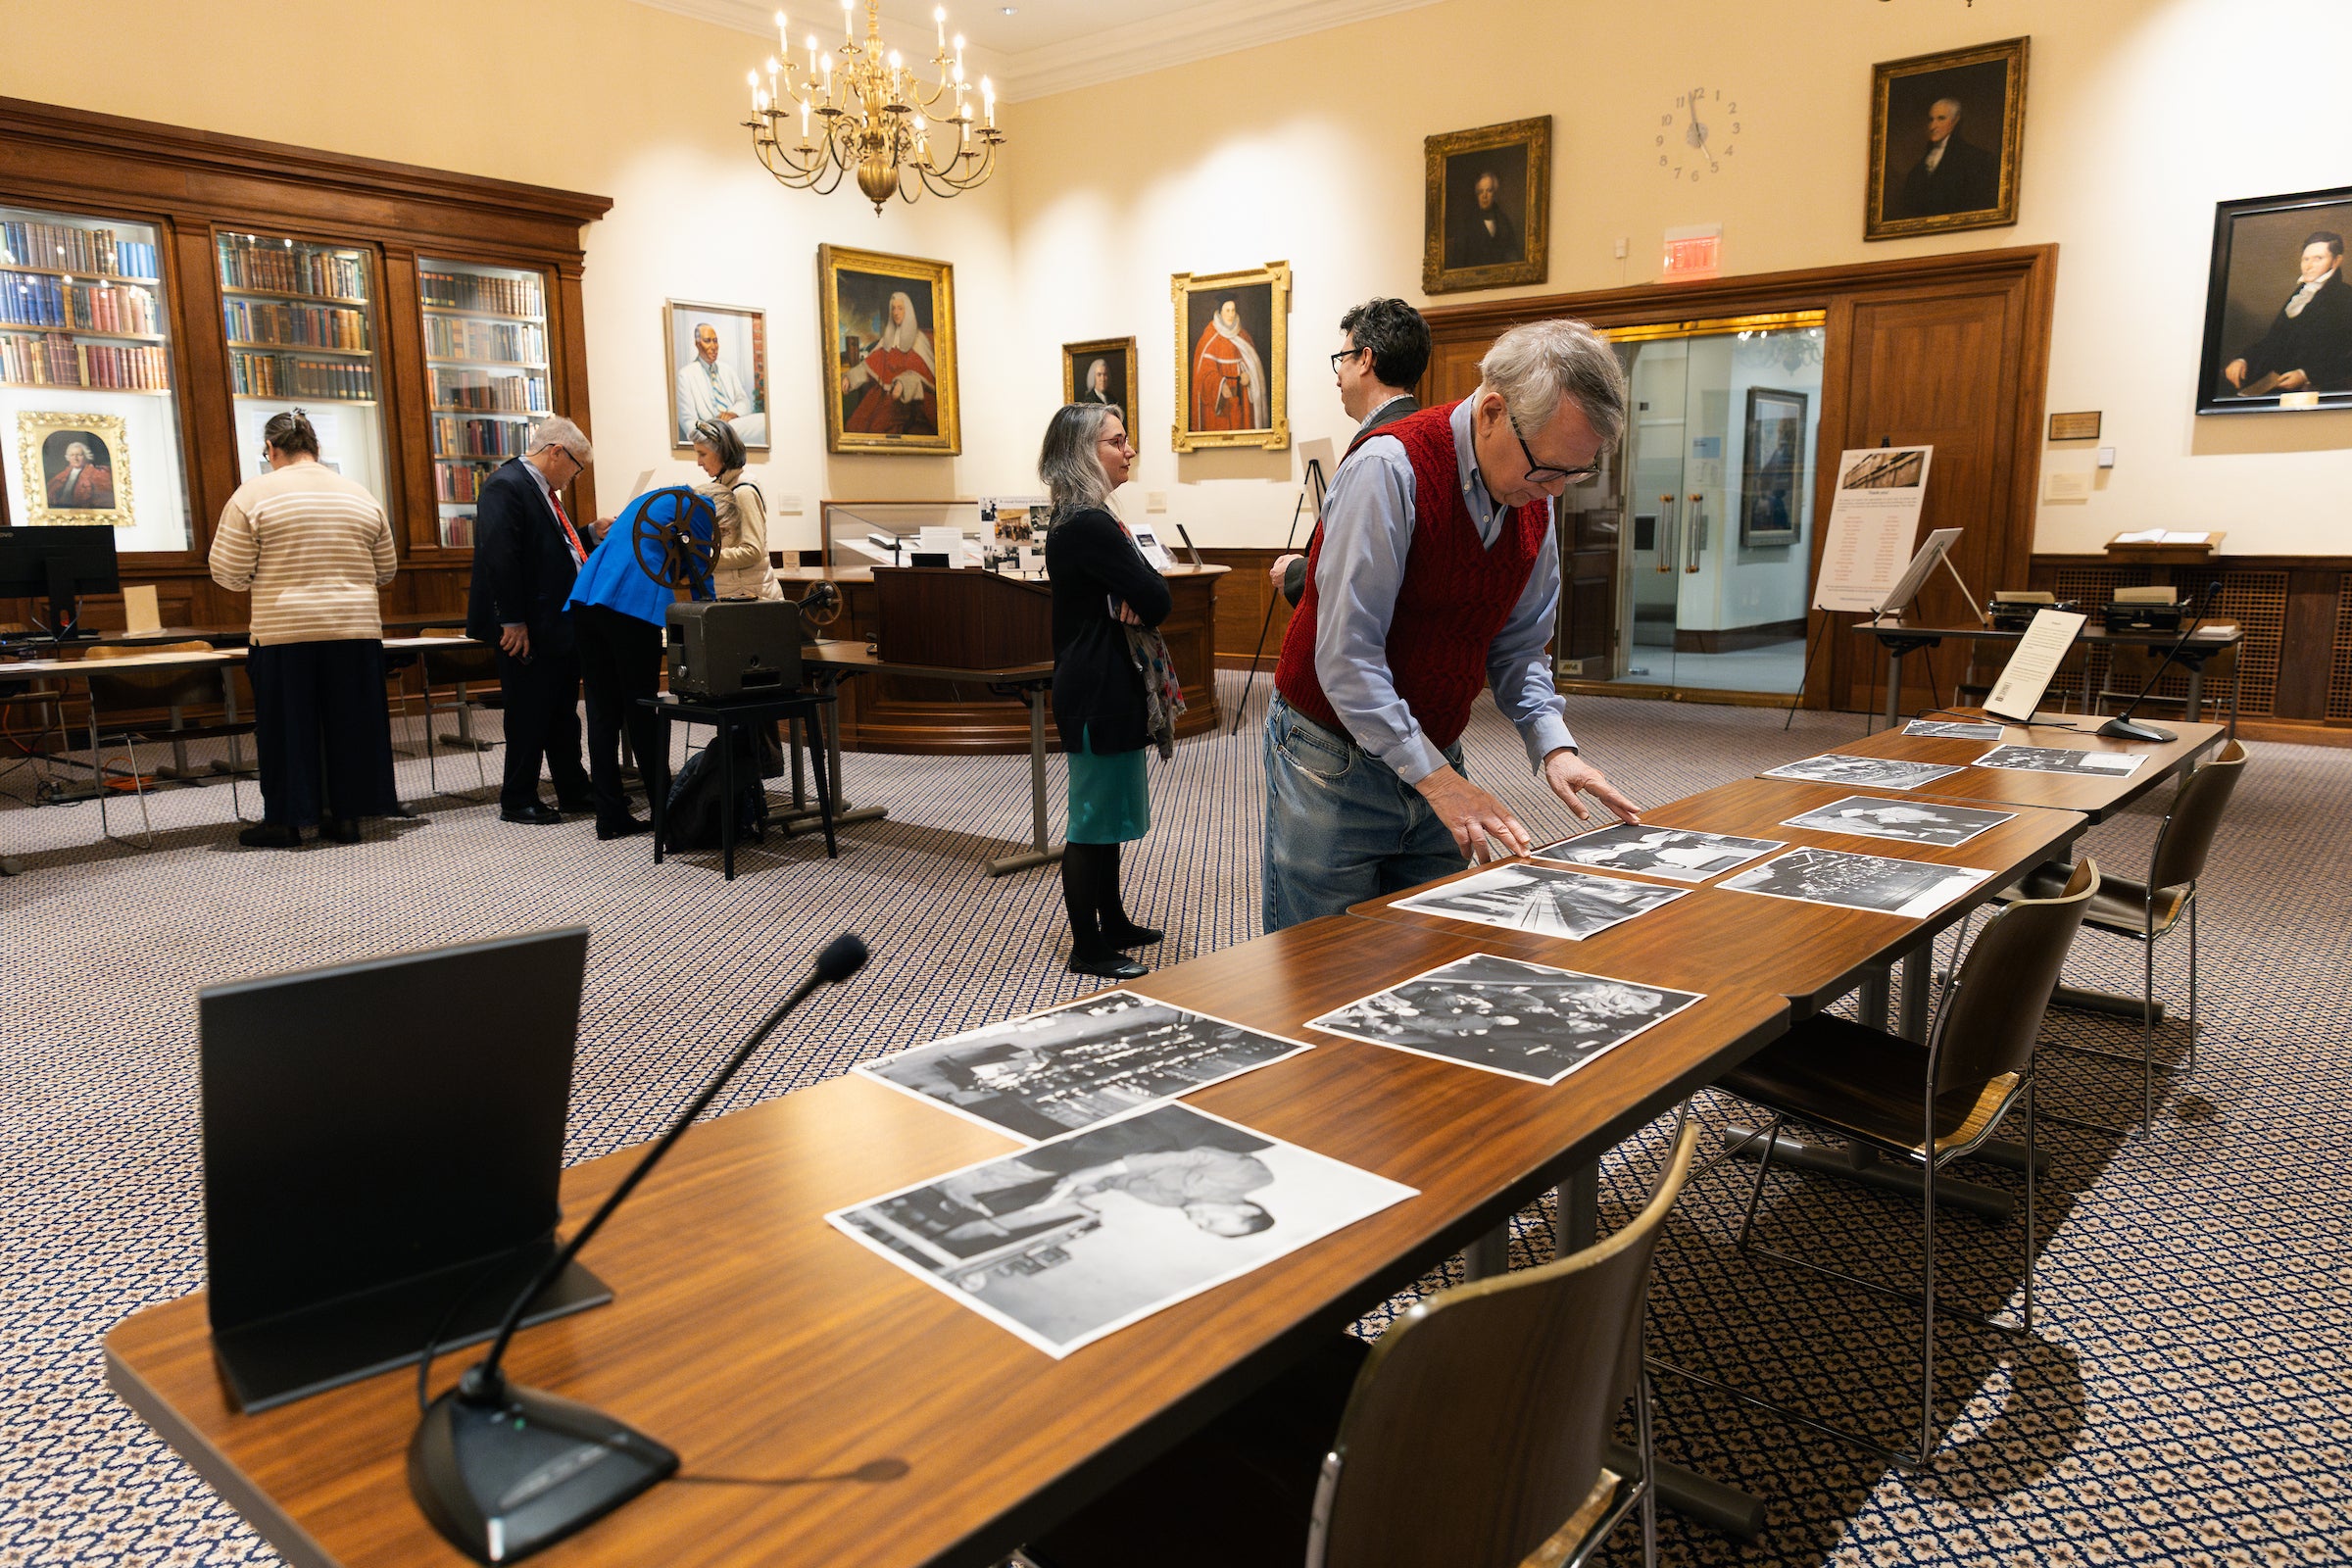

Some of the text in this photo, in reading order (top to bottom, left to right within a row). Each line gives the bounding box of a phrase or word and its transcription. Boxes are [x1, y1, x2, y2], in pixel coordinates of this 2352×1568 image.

[1692, 86, 1705, 100] 12
[1676, 96, 1685, 109] 11
[1728, 101, 1737, 115] 2
[1661, 114, 1672, 126] 10
[1732, 122, 1740, 134] 3
[1655, 135, 1664, 146] 9
[1724, 144, 1734, 156] 4
[1659, 156, 1668, 167] 8
[1710, 161, 1719, 173] 5
[1674, 167, 1682, 179] 7
[1690, 171, 1699, 182] 6
